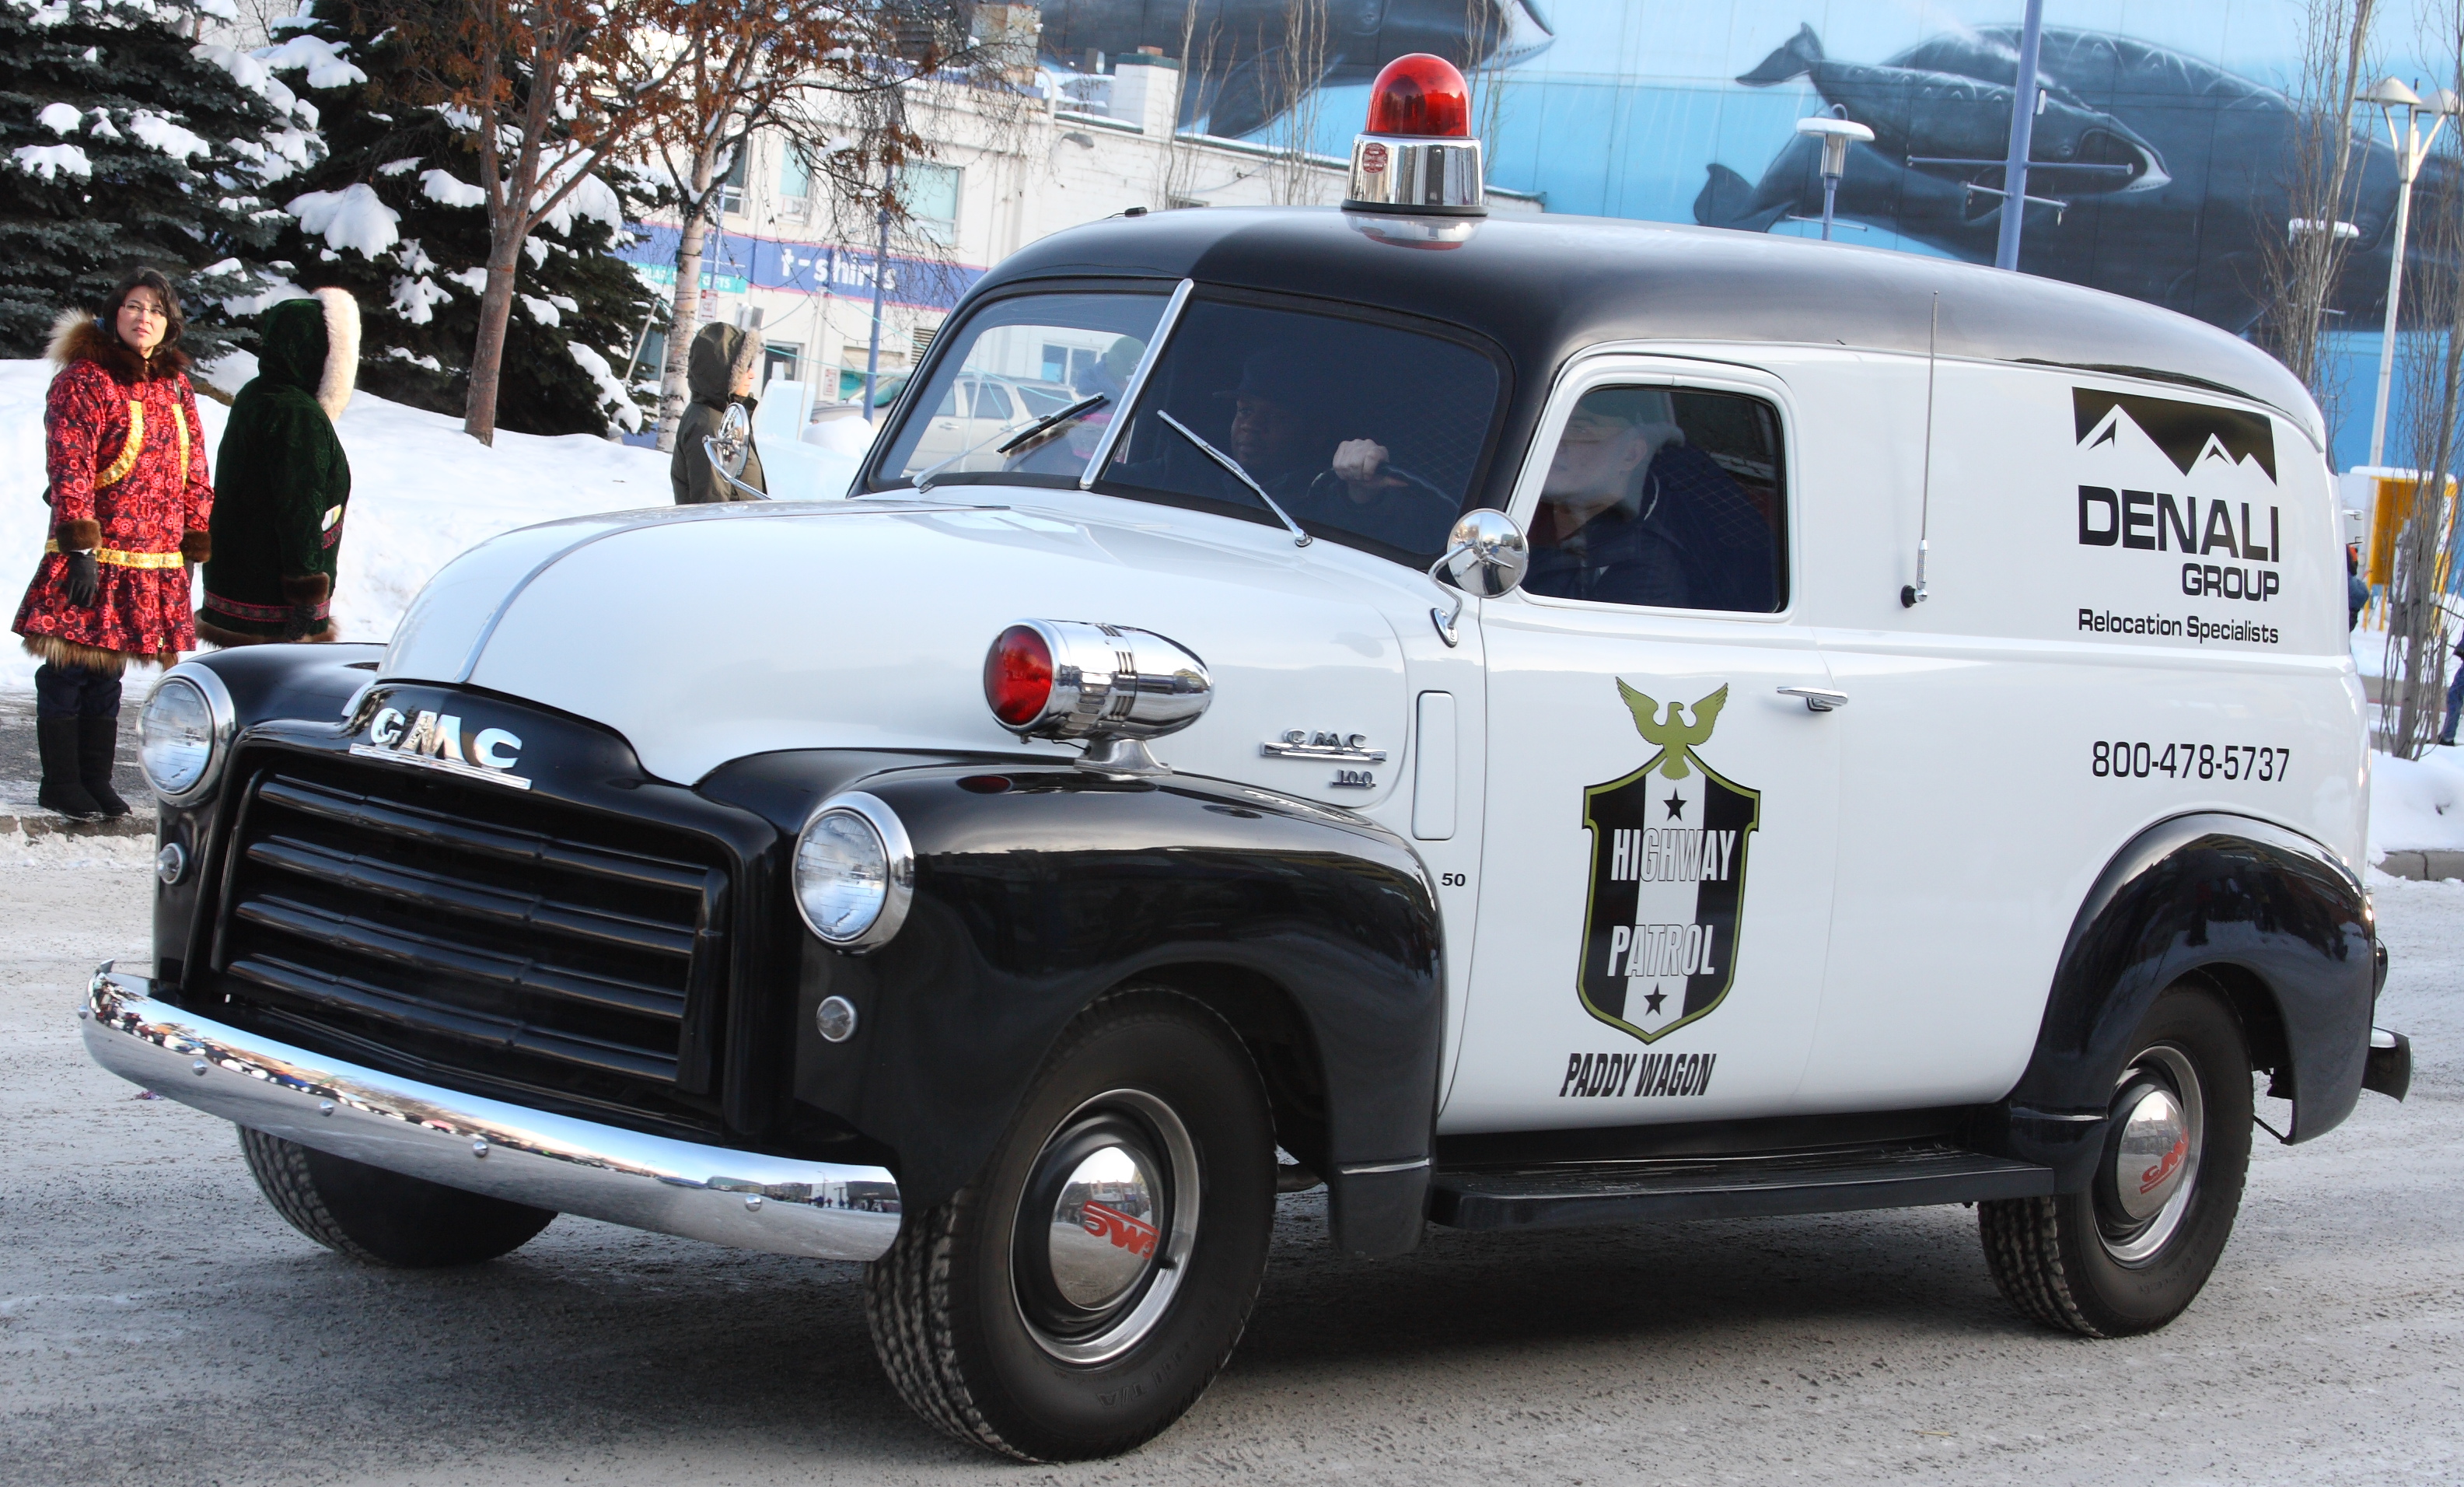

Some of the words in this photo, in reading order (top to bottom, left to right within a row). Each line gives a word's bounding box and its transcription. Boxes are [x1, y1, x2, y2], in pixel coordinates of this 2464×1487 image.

[2078, 484, 2280, 563] DENALI
[2182, 562, 2280, 602] GROUP
[2078, 607, 2182, 638] Relocation
[2186, 615, 2279, 645] Specialists
[370, 707, 523, 768] GMC
[1282, 728, 1368, 749] GMC
[1337, 768, 1374, 785] 100
[2092, 740, 2291, 782] 800-478-5737
[1609, 827, 1737, 882] HIGHWAY
[1441, 872, 1466, 887] 50
[1606, 923, 1715, 978] PATROL
[1558, 1052, 1637, 1098] PADDY
[1634, 1052, 1718, 1098] WAGON
